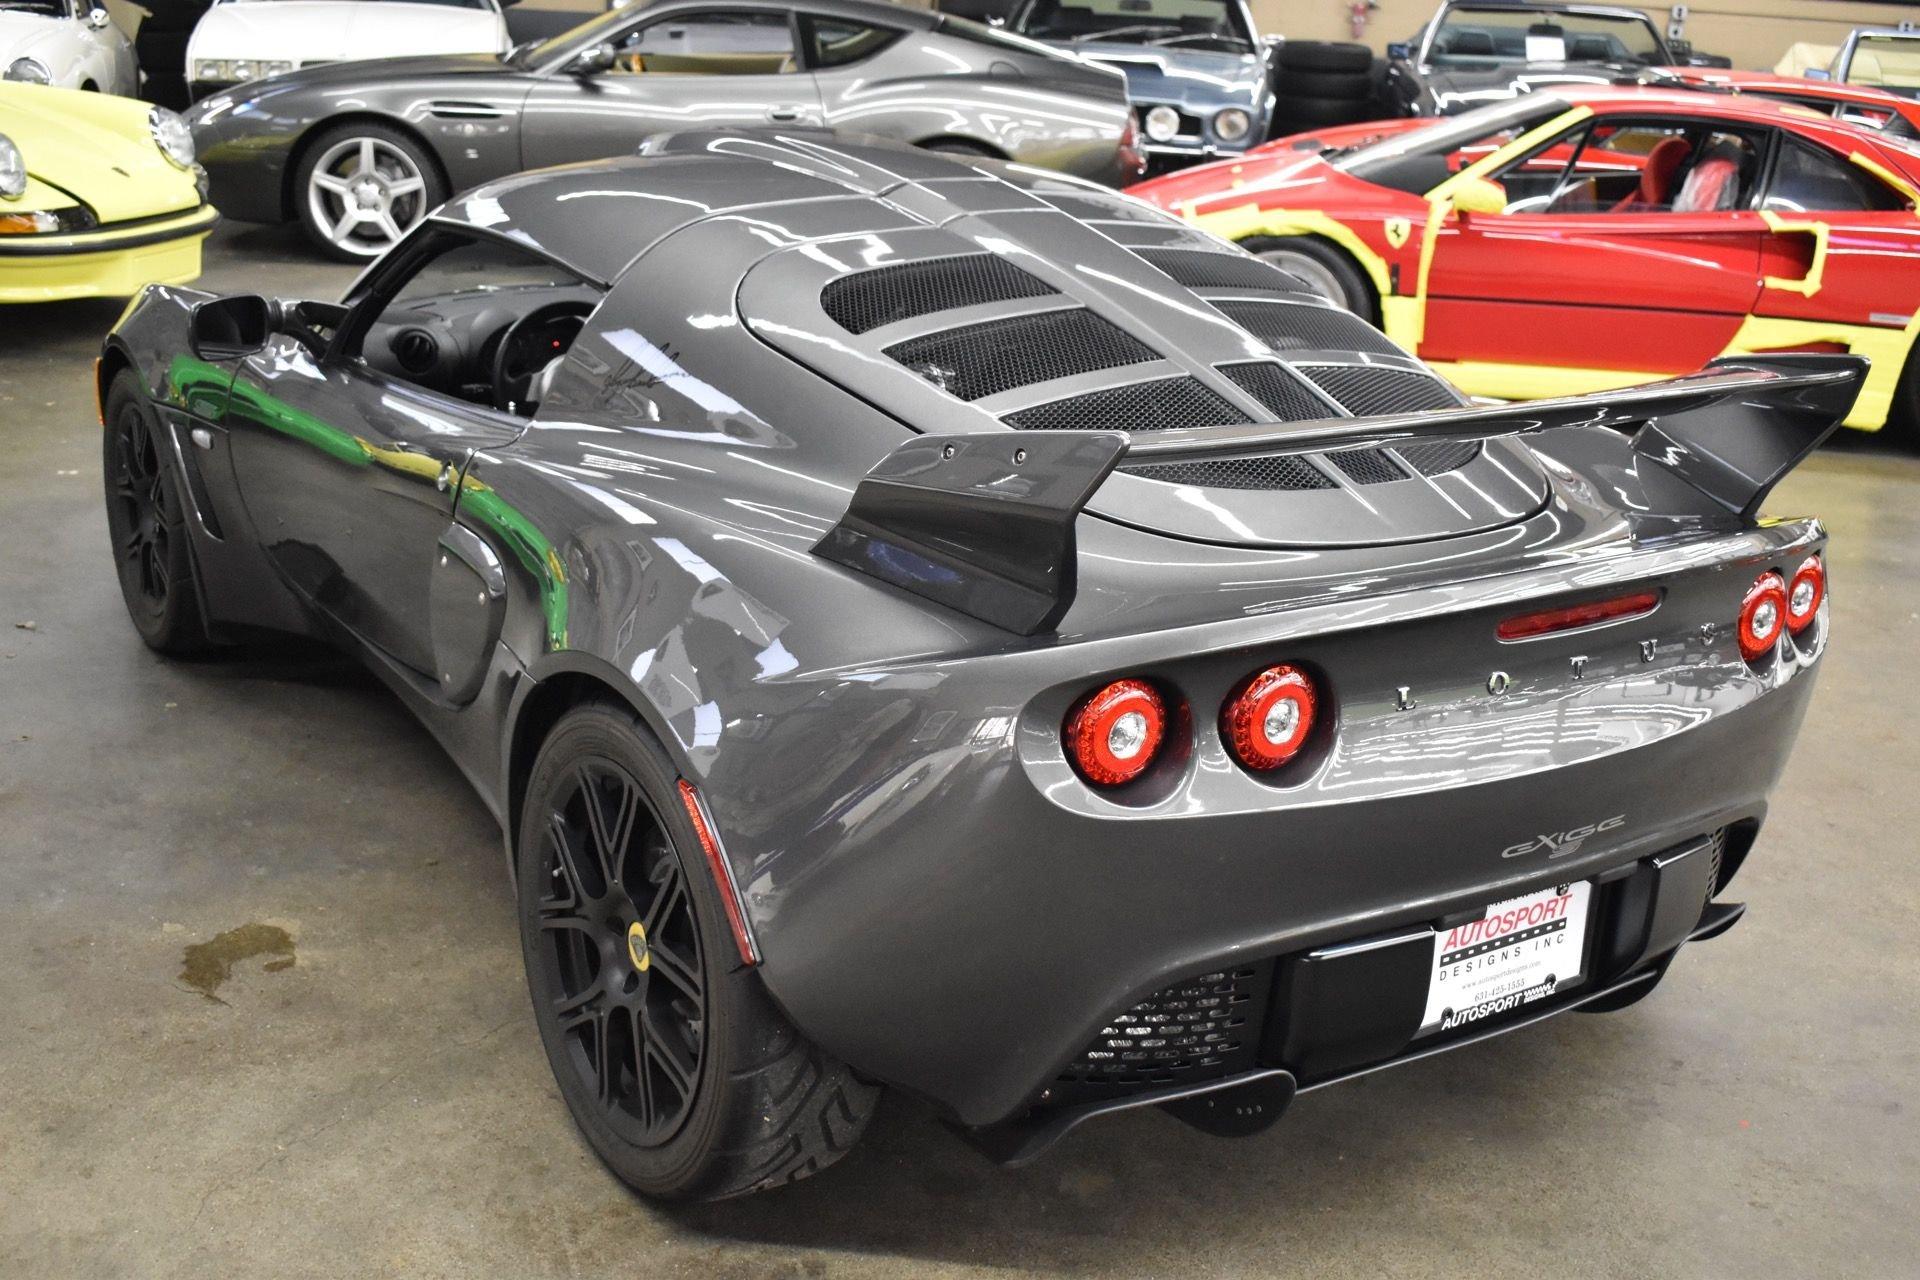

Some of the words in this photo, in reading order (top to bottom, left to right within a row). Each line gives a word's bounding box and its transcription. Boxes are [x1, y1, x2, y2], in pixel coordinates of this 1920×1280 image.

[1395, 622, 1717, 712] LOTUS
[1443, 894, 1573, 951] AUTOSPORT
[1439, 947, 1521, 981] DESIGNS
[1534, 934, 1564, 951] INC
[1441, 992, 1523, 1031] AUTOSPORT
